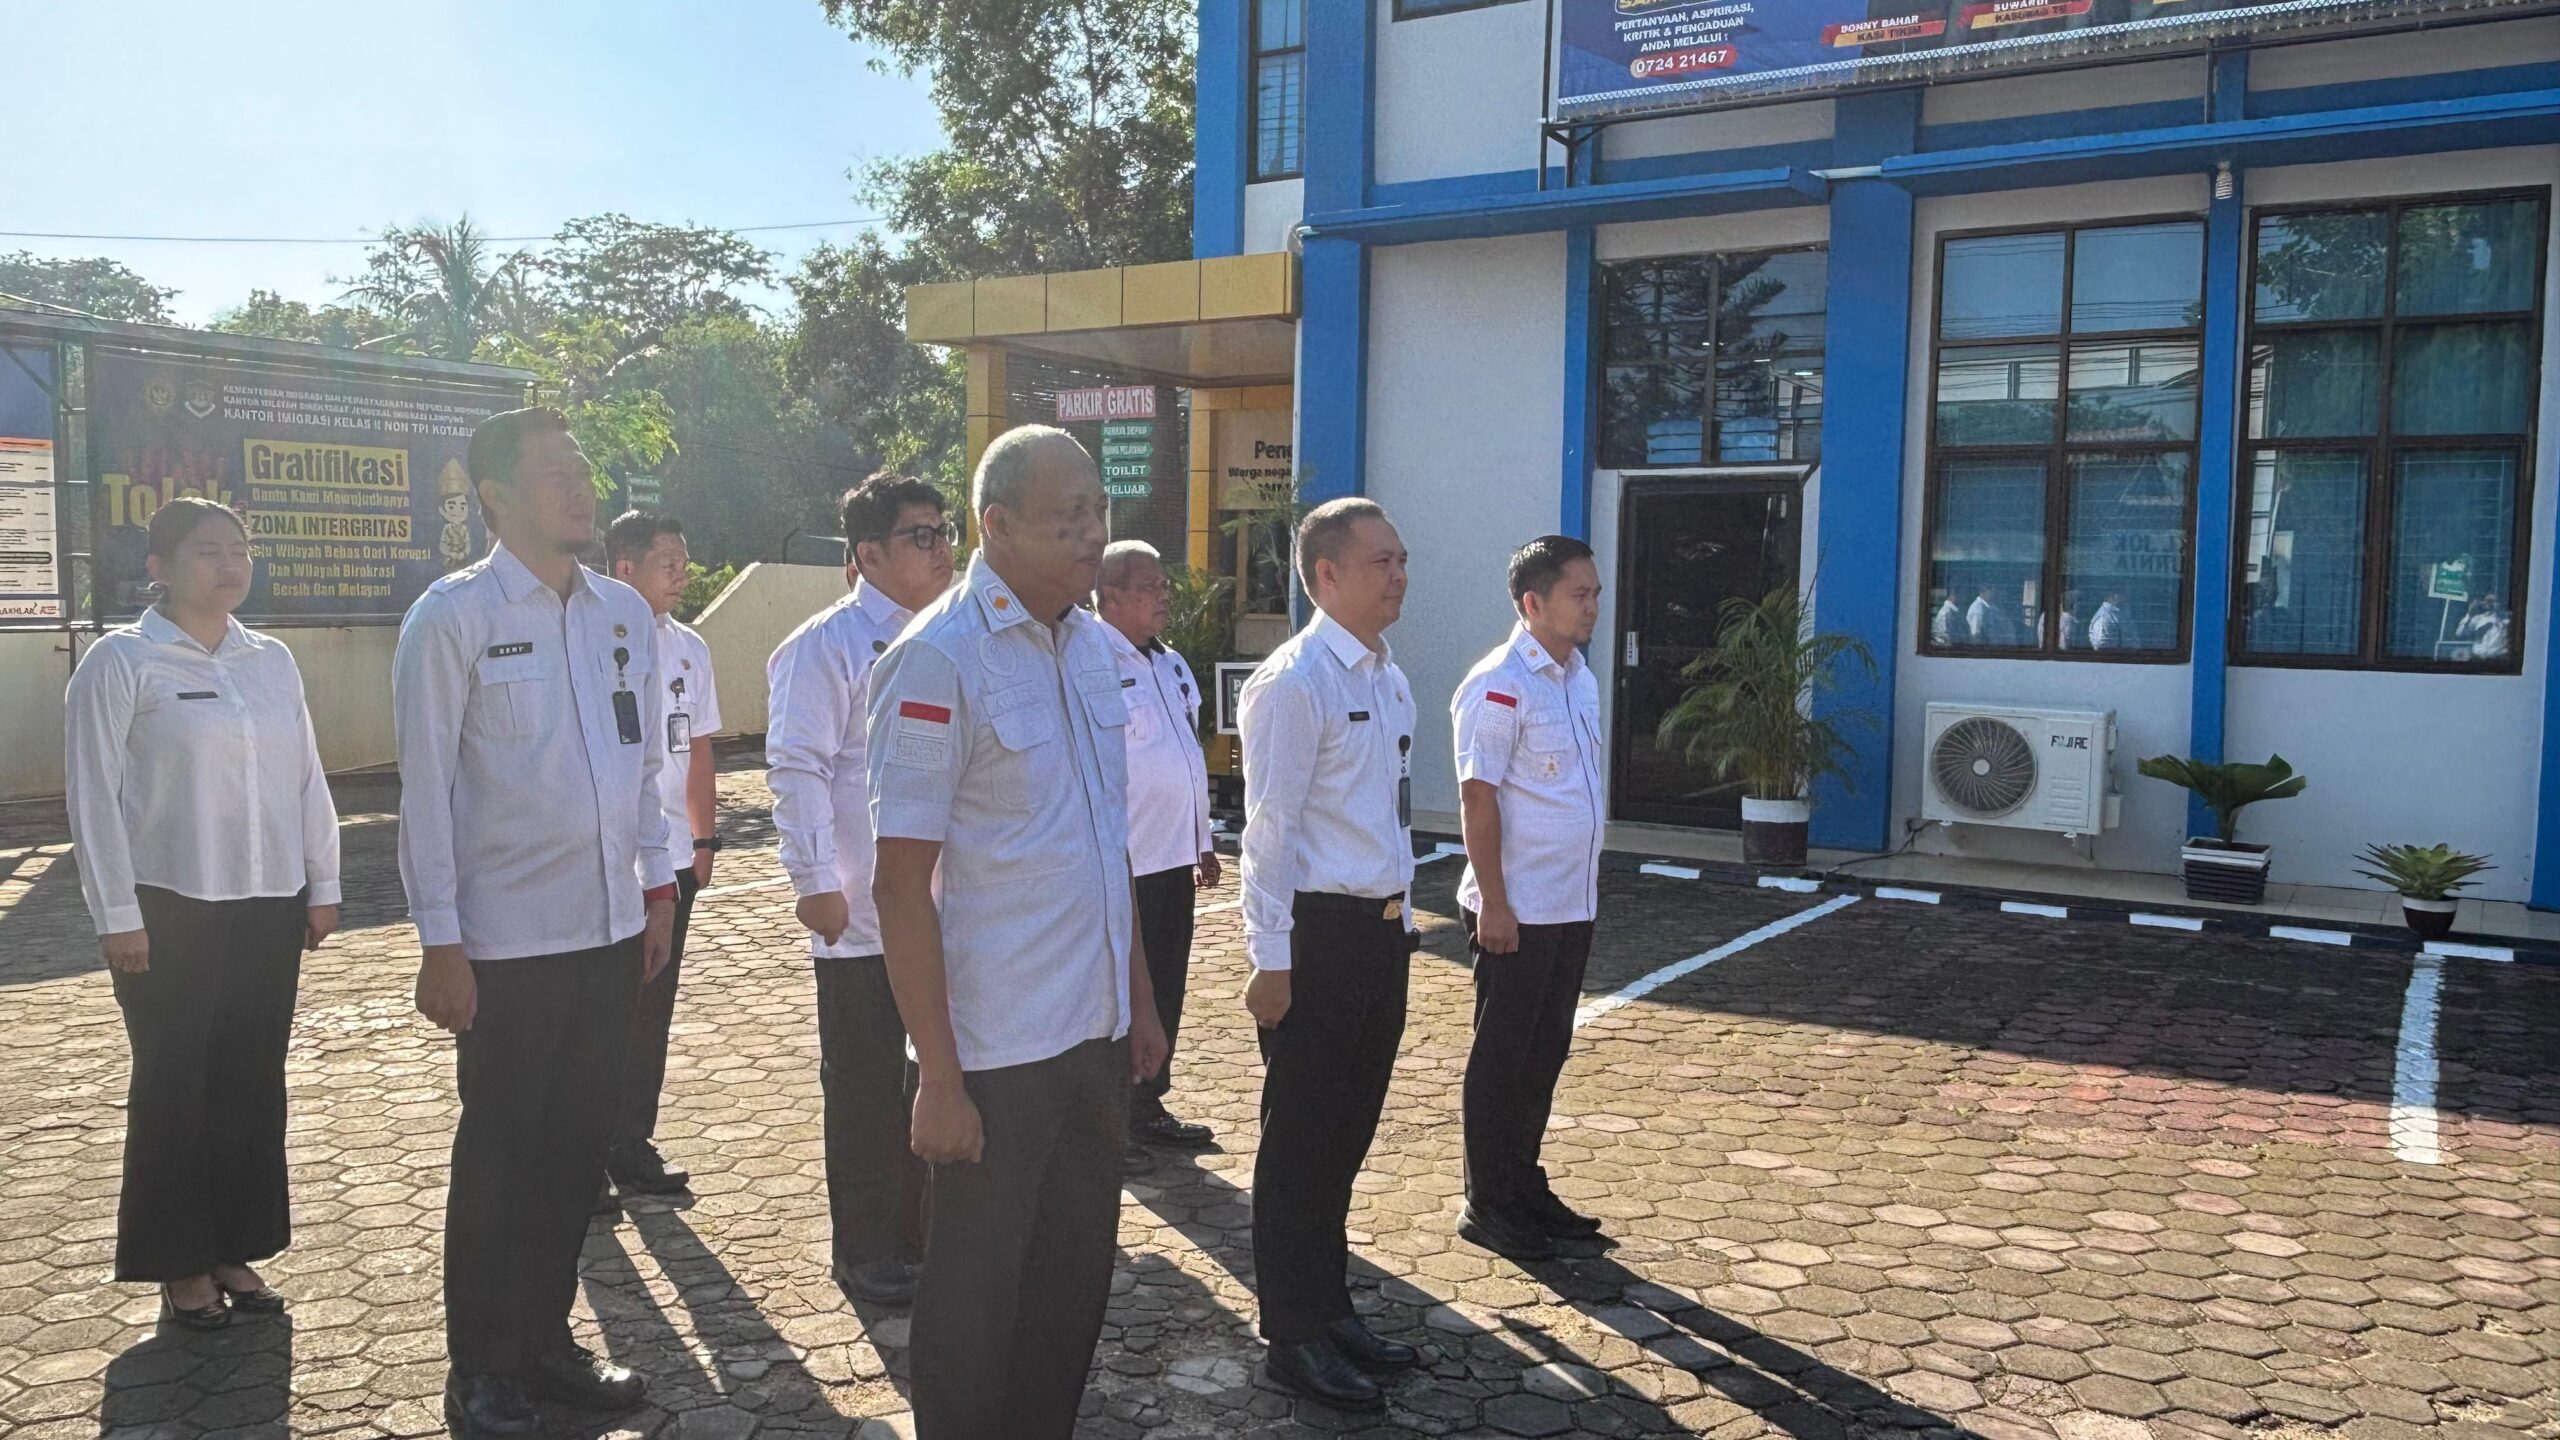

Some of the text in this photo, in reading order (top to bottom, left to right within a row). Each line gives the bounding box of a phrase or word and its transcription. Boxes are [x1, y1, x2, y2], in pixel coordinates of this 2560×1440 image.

[1614, 13, 1690, 31] PERTANYAAN,
[1623, 17, 1744, 42] KRITIK & PENGADUAN
[1640, 40, 1671, 53] ANDA
[1673, 33, 1722, 48] MELALUI
[1636, 50, 1727, 74] 0724 21467
[1059, 388, 1153, 417] PARKIR GRATIS
[224, 408, 274, 423] KANTOR
[277, 412, 331, 427] IMIGRASI
[334, 416, 371, 430] KELAS
[384, 420, 409, 433] NON
[411, 422, 429, 435] TPI
[432, 424, 476, 438] KOTABU
[251, 443, 403, 487] Gratifikasi
[1104, 465, 1146, 476] TOILET
[1104, 483, 1146, 495] KELUAR
[251, 514, 408, 538] ZONA INTERGRITAS
[276, 543, 322, 559] Wilayah
[390, 547, 431, 561] Korupsi
[268, 562, 293, 578] Dan
[293, 563, 340, 580] Wilayah
